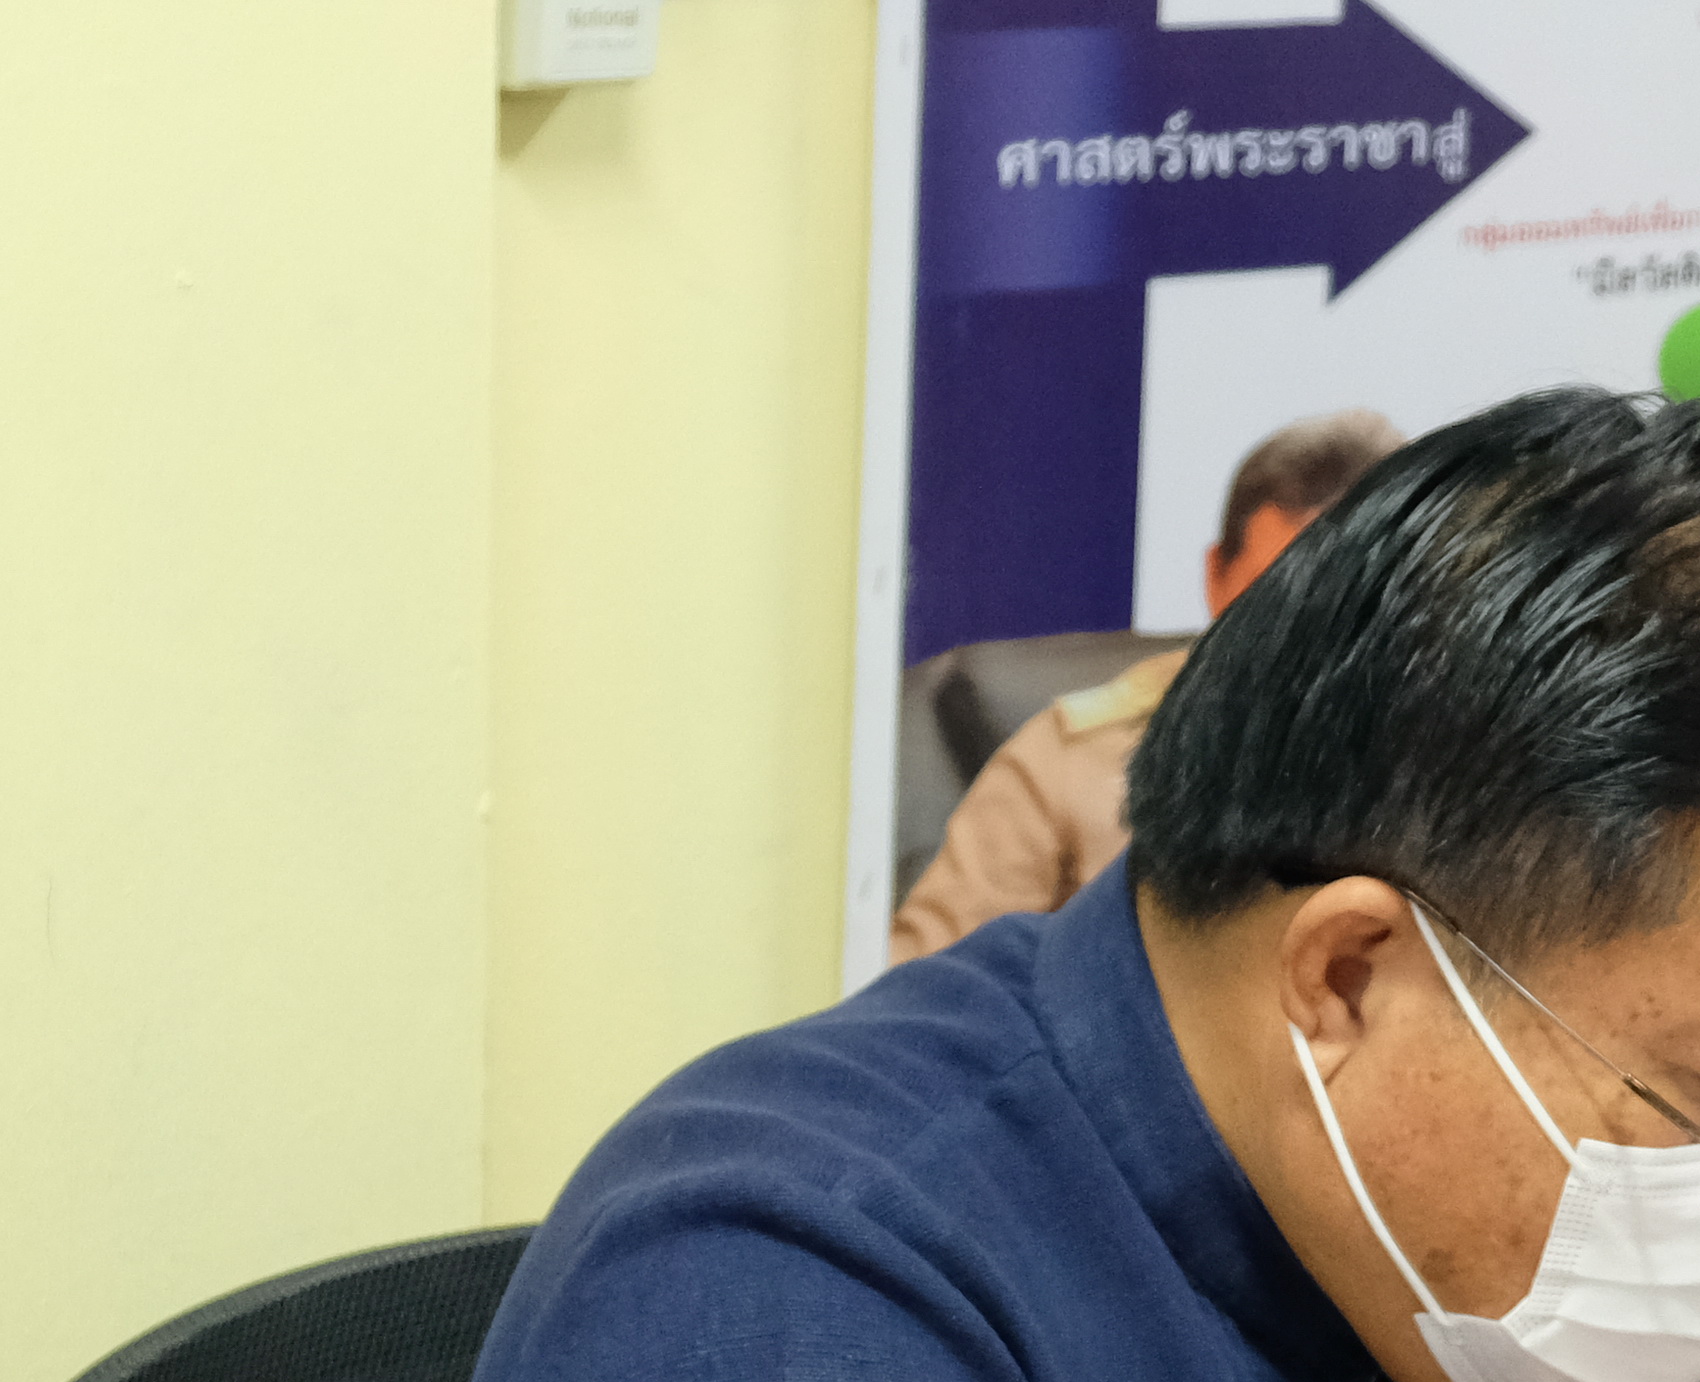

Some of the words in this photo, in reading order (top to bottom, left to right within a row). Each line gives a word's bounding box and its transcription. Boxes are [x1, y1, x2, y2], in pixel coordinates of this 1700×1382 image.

[997, 107, 1469, 188] ศาสตร์พระราชาสู่
